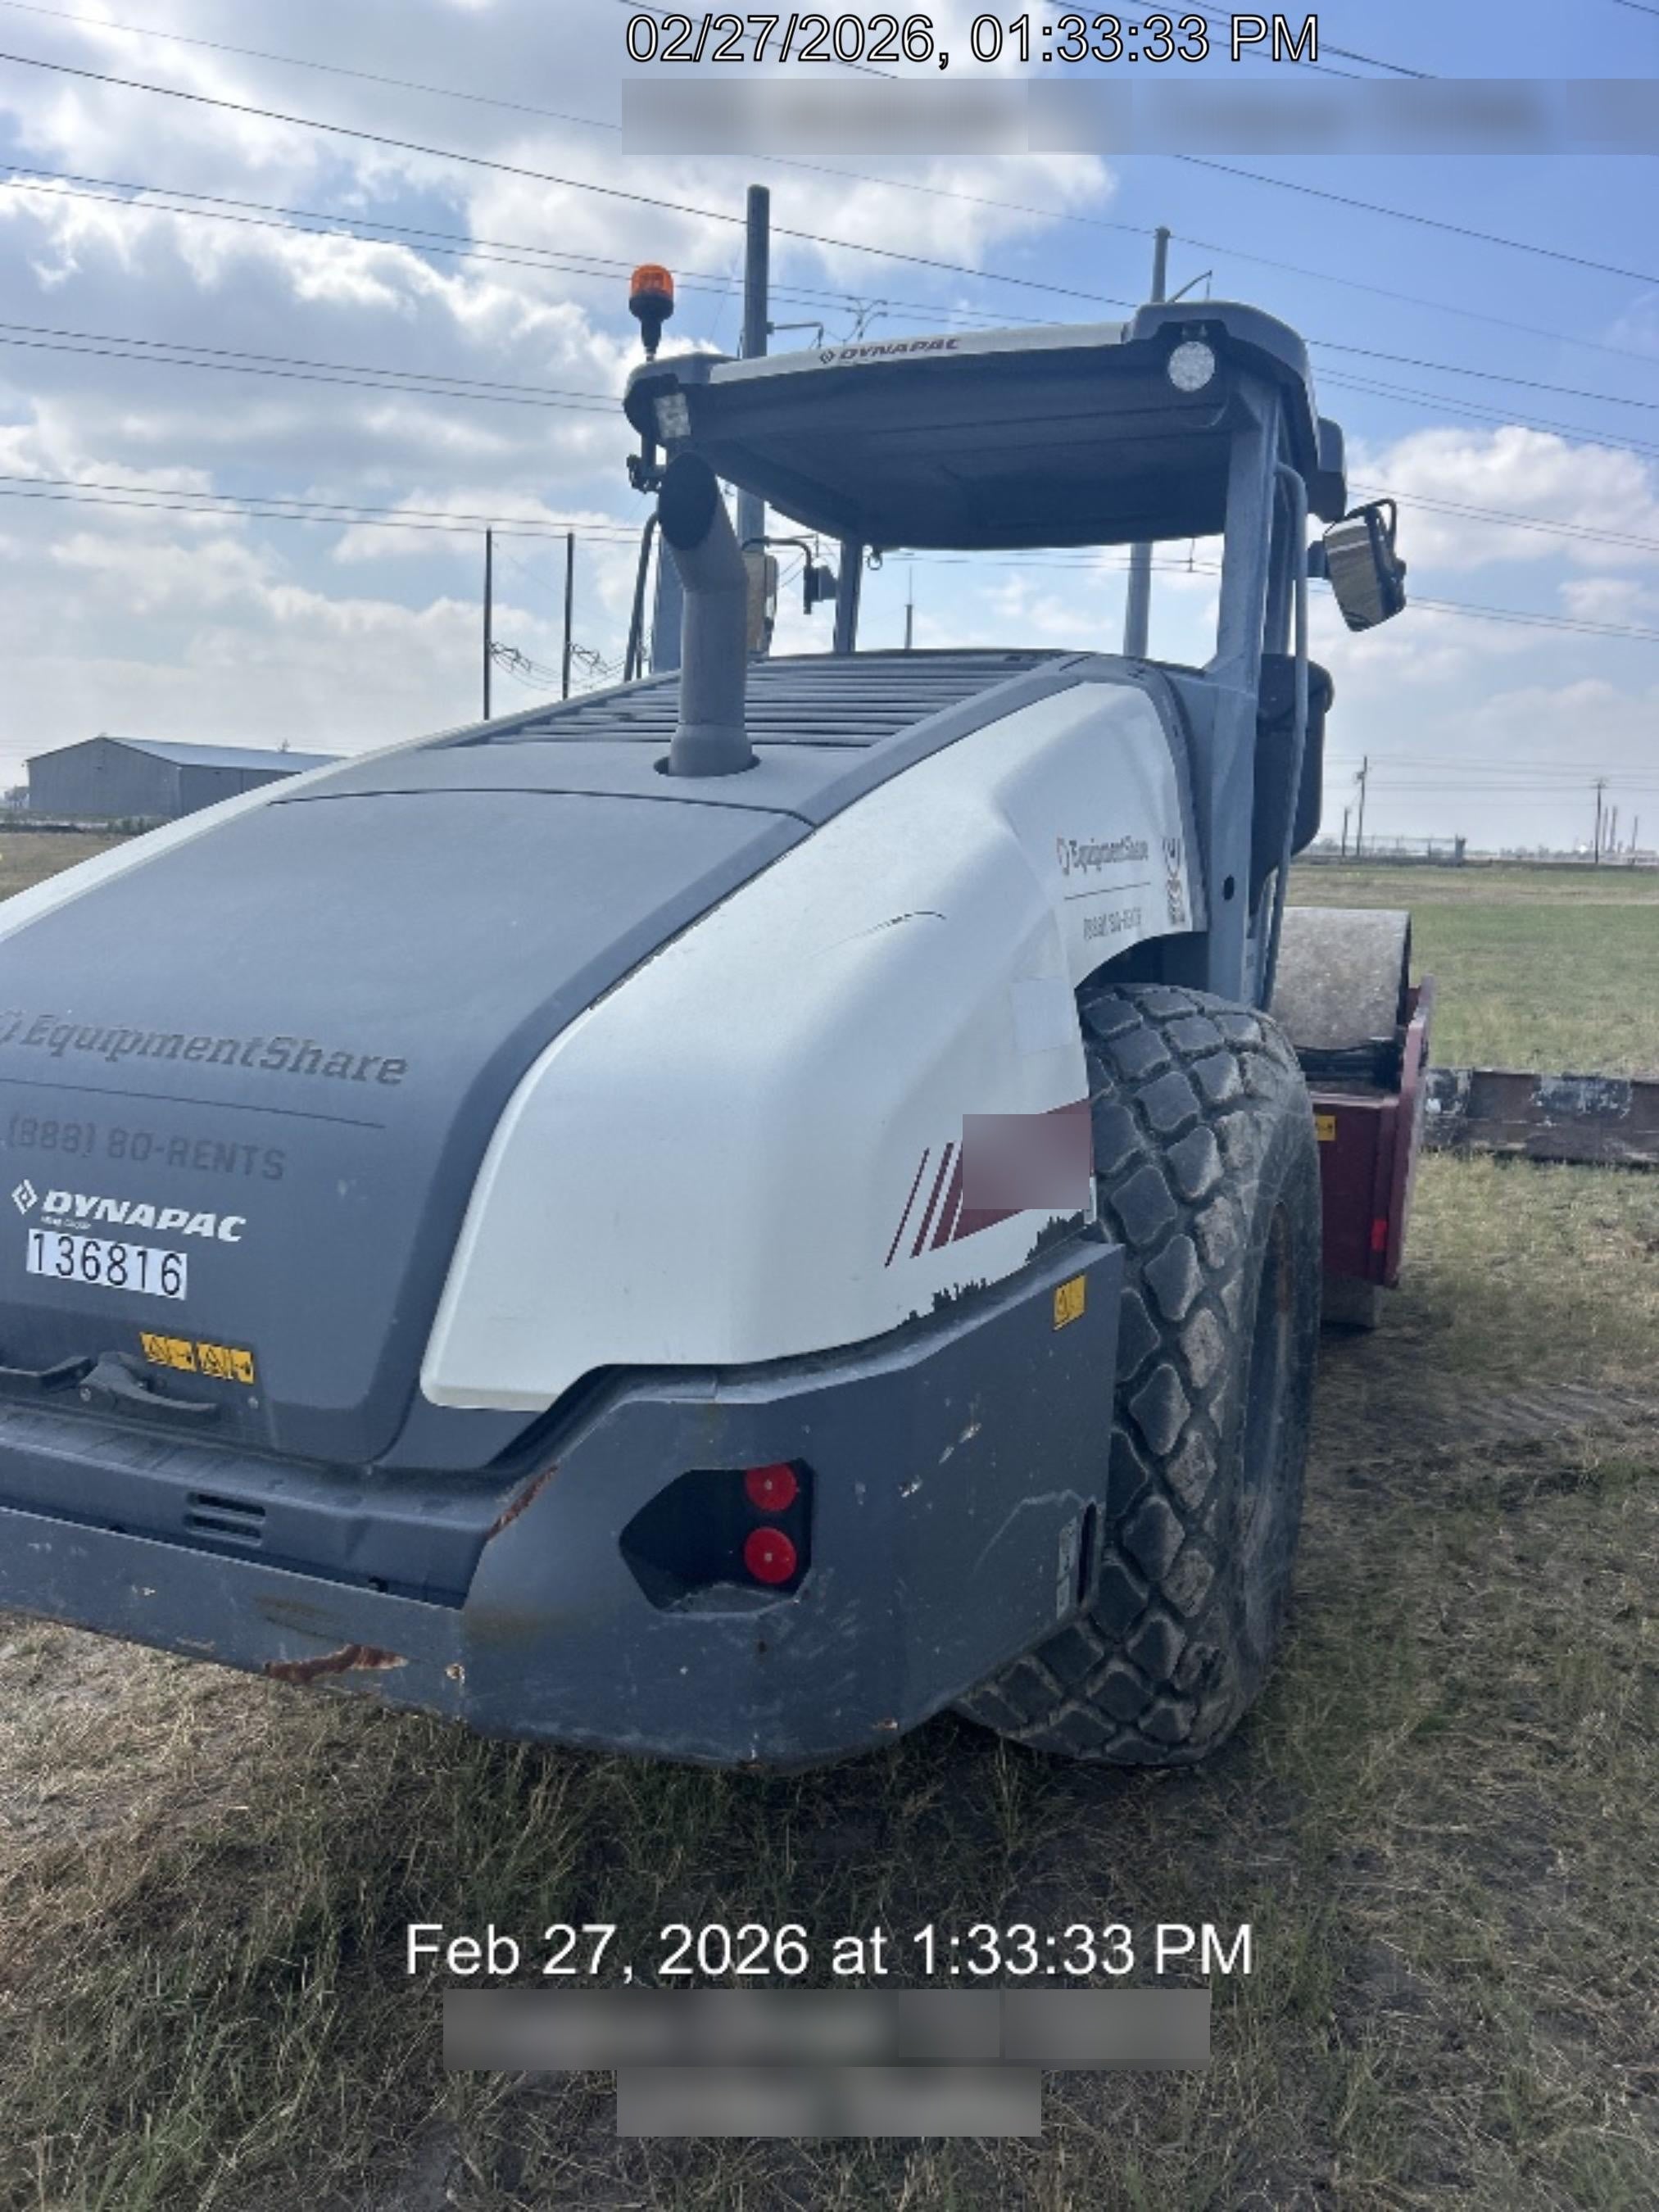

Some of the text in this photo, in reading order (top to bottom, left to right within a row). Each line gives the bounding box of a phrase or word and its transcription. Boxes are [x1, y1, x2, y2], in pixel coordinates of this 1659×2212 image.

[840, 338, 961, 360] DYNAPAC
[20, 1014, 408, 1086] EquipmentShare
[8, 1113, 287, 1181] (888) 80-RENTS
[43, 1190, 247, 1243] DYNAPAC
[31, 1232, 183, 1296] 136816
